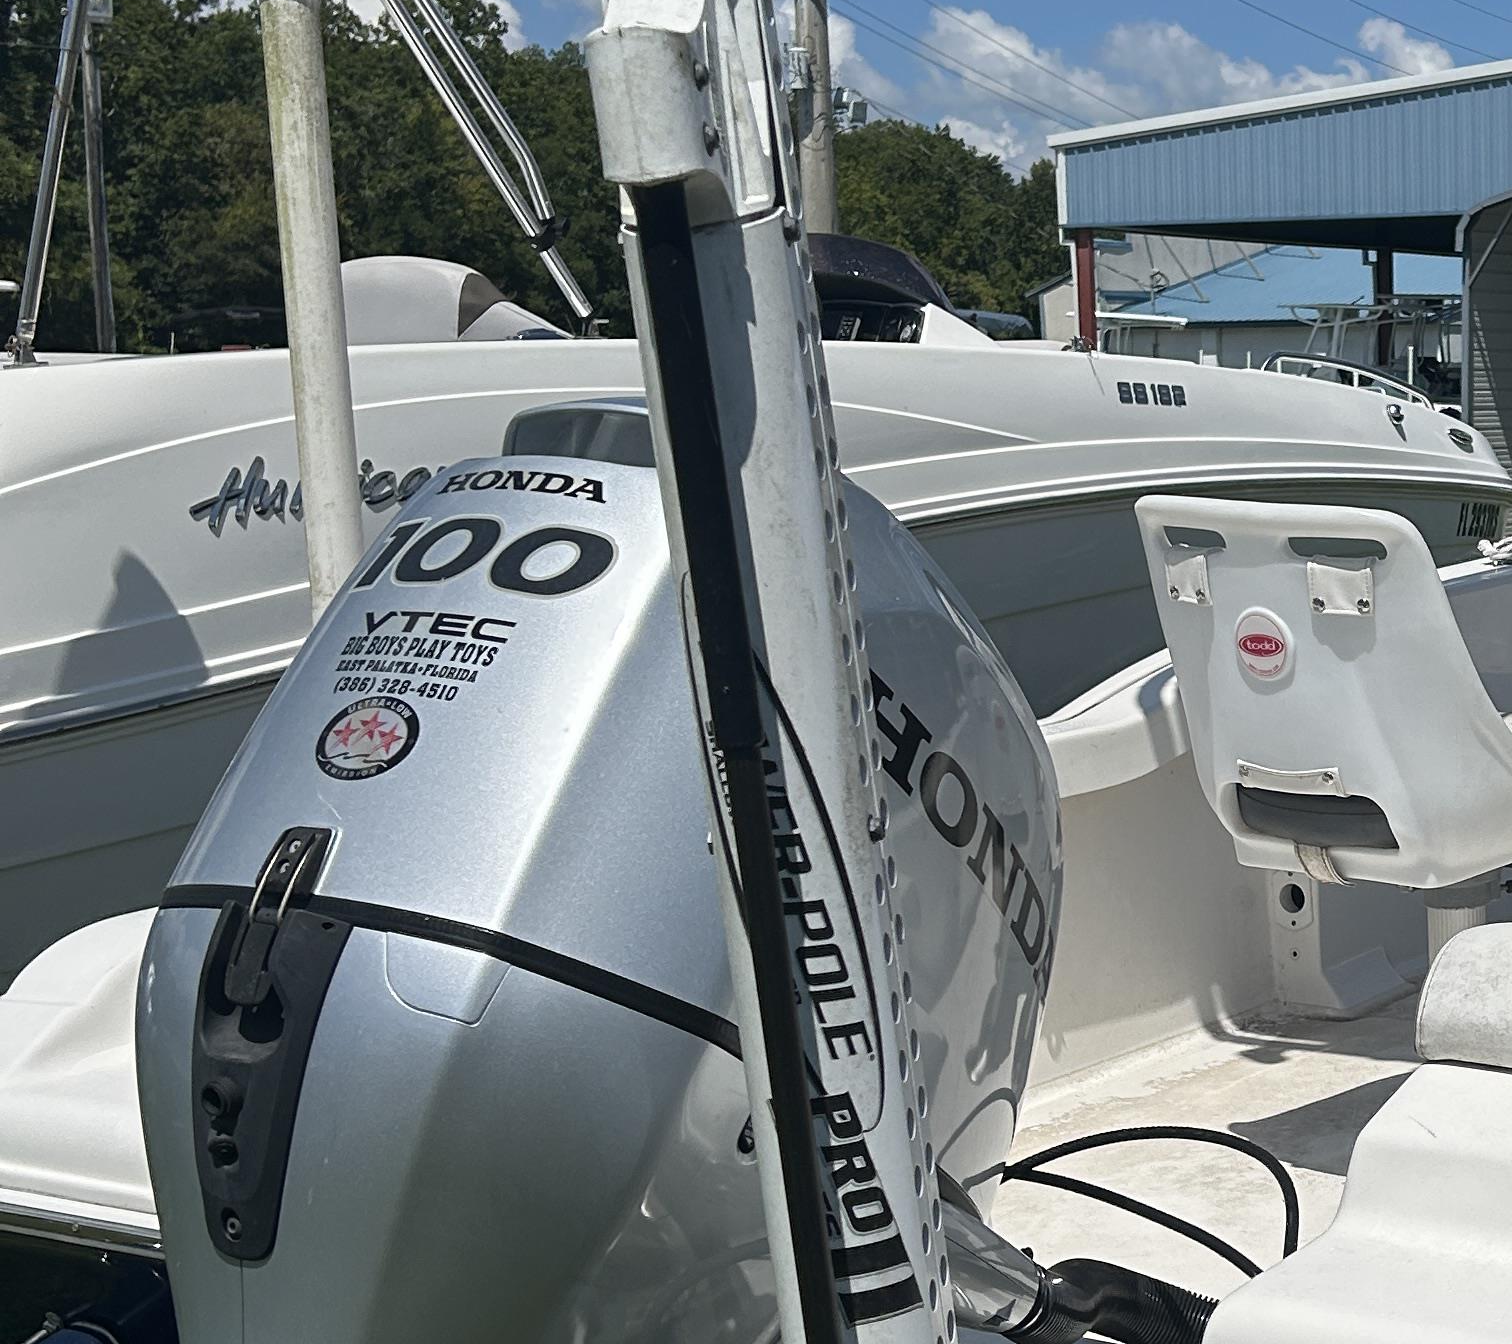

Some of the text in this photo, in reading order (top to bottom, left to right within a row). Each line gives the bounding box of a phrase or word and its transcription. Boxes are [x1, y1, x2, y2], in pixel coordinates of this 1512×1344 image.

[437, 470, 608, 504] HONDA
[350, 515, 619, 599] 100
[366, 611, 517, 644] VTEC
[341, 636, 499, 667] BIG BOYS PLAY TOYS
[1247, 639, 1276, 651] todd
[336, 659, 367, 672] EAST
[333, 677, 459, 702] (386) 328-4510
[809, 1091, 894, 1234] PRO
